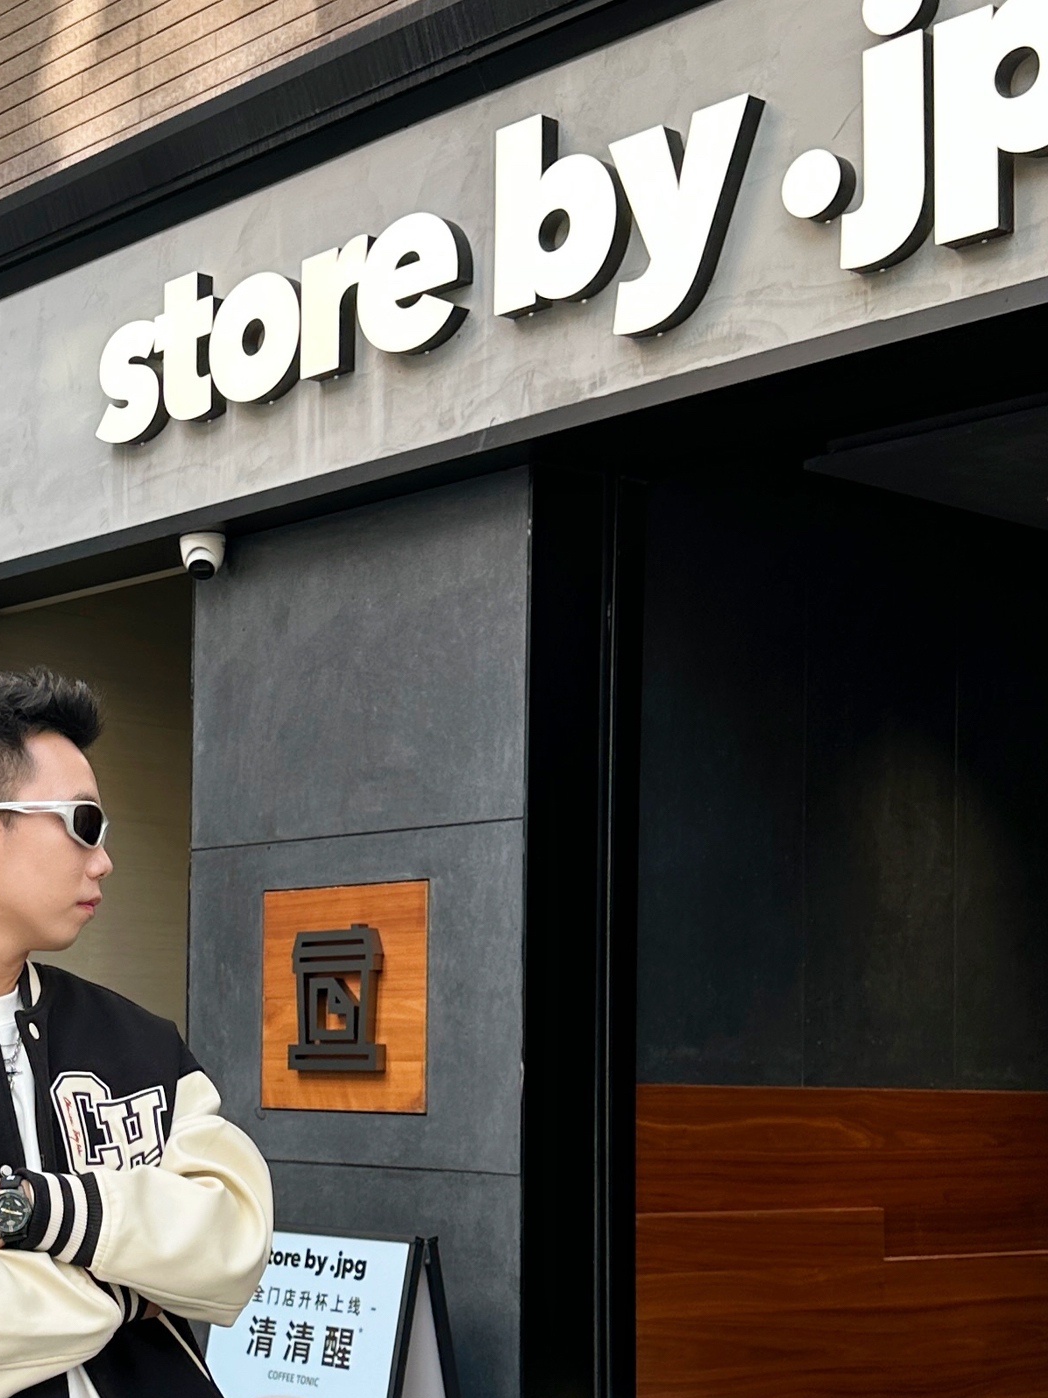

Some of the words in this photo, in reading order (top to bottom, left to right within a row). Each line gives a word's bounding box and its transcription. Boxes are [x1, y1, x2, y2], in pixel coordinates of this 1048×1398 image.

[95, 211, 470, 445] store
[494, 93, 760, 337] by
[267, 1246, 301, 1268] tore
[304, 1248, 328, 1277] by
[330, 1250, 367, 1281] .jpg
[246, 1315, 354, 1370] 清清醒
[267, 1369, 295, 1384] COFFEE
[296, 1374, 320, 1388] TONIC
